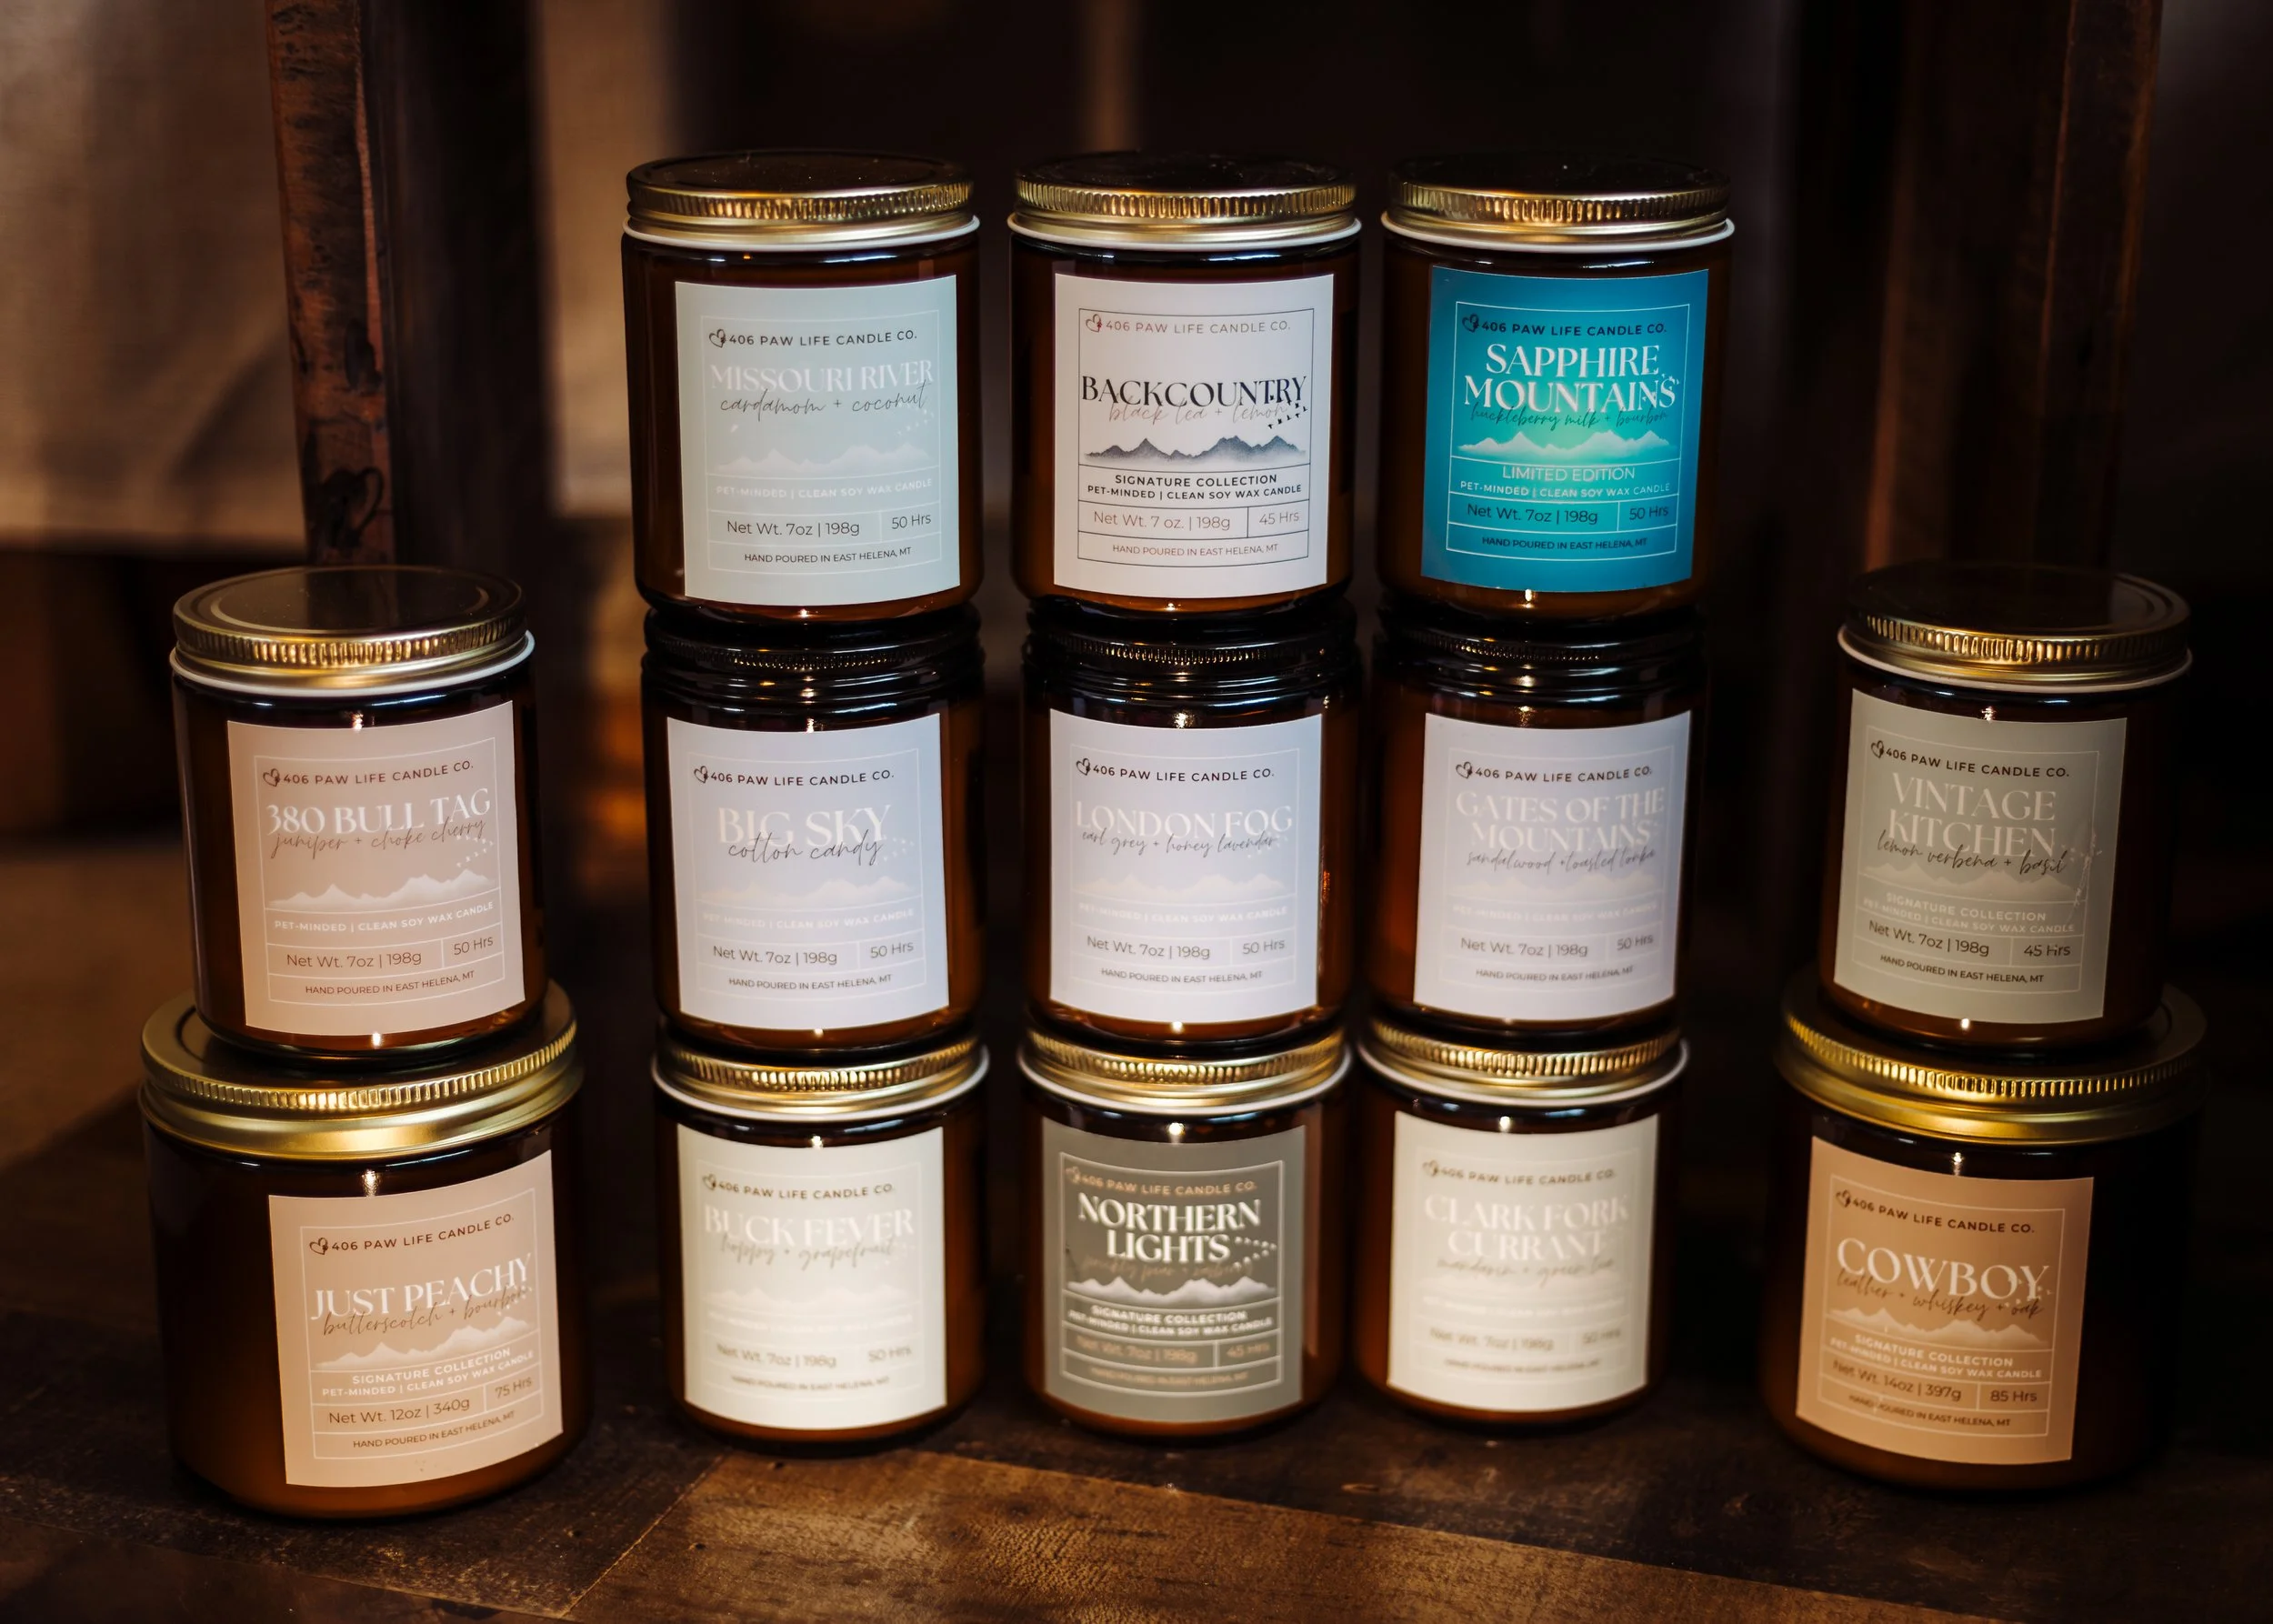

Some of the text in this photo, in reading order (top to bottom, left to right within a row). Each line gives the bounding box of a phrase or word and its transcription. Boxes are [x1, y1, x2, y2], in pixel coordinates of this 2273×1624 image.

[729, 330, 917, 346] 406 PAW LIFE CANDLE CO.
[1106, 321, 1290, 334] 406 PAW LIFE CANDLE CO.
[1482, 322, 1667, 336] 406 PAW LIFE CANDLE CO.
[1486, 344, 1659, 377] SAPPHIRE
[710, 359, 934, 393] MISSOURI RIVER
[1082, 376, 1307, 406] BACKCOUNTRY
[721, 379, 930, 421] cardamom coconut
[1465, 376, 1676, 412] MOUNTAINS
[1471, 402, 1668, 431] huckleberry milk bourbon
[1115, 475, 1277, 486] SIGNATURE COLLECTION
[1503, 466, 1635, 481] LIMITED EDITION
[1088, 486, 1156, 499] PET-MINDED
[1209, 490, 1231, 499] SOY
[1236, 489, 1259, 497] WAX
[1264, 485, 1301, 496] CANDLE
[892, 513, 931, 529] 50 Hrs
[1259, 512, 1299, 525] 45 Hrs
[1467, 503, 1597, 525] Net Wt. 7oz 198g
[1629, 505, 1668, 520] 50 Hrs
[727, 521, 860, 536] Net Wt. 7oz 198g
[745, 547, 911, 563] HAND POURED IN EAST HELENA, MT
[284, 760, 474, 785] 406 PAW LIFE CANDLE CO.
[711, 769, 894, 786] 406 PAW LIFE CANDLE CO.
[1093, 765, 1274, 782] 406 PAW LIFE CANDLE CO.
[1476, 766, 1651, 782] 406 PAW LIFE CANDLE CO.
[1886, 748, 2068, 777] 406 PAW LIFE CANDLE CO.
[266, 787, 490, 835] 380 BULL TAG
[1456, 787, 1665, 823] GATES OF THE
[1892, 772, 2057, 821] VINTAGE
[718, 805, 891, 847] BIG SKY
[1076, 801, 1292, 838] LONDON FOG
[1887, 808, 2056, 857] KITCHEN
[271, 816, 486, 858] juniper choke cherry
[729, 829, 883, 866] cotton candy
[1083, 827, 1212, 857] earl grey honey
[1471, 821, 1651, 852] MOUNTAINS
[1877, 829, 2068, 875] lemon verbena basil
[275, 902, 494, 932] PET-MINDED CLEAN SOY WAX CANDLE
[454, 937, 494, 955] 50 Hrs
[870, 942, 913, 958] 50 Hrs
[1869, 920, 1988, 957] Net Wt. 7oz 198g
[779, 1187, 868, 1199] LIFE CANDLE
[1142, 1183, 1230, 1196] LIFE CANDLE
[705, 1205, 915, 1248] BUCK FEVER
[1078, 1192, 1261, 1233] NORTHERN
[1425, 1193, 1629, 1231] CLARK FORK
[1914, 1213, 2035, 1234] LIFE CANDLE CO.
[332, 1214, 514, 1251] 406 PAW LIFE CANDLE CO.
[1107, 1229, 1230, 1263] LIGHTS
[1447, 1228, 1607, 1261] CURRANT
[1837, 1237, 2049, 1300] COWBOY
[310, 1252, 532, 1320] JUST PEACHY
[324, 1287, 528, 1336] butterscotch bourbon
[1913, 1289, 1988, 1321] whiskey
[353, 1348, 511, 1384] SIGNATURE COLLECTION
[1926, 1383, 1961, 1401] 397g
[1990, 1388, 2037, 1402] 85 Hrs
[329, 1398, 469, 1423] Net Wt. 12oz 340g
